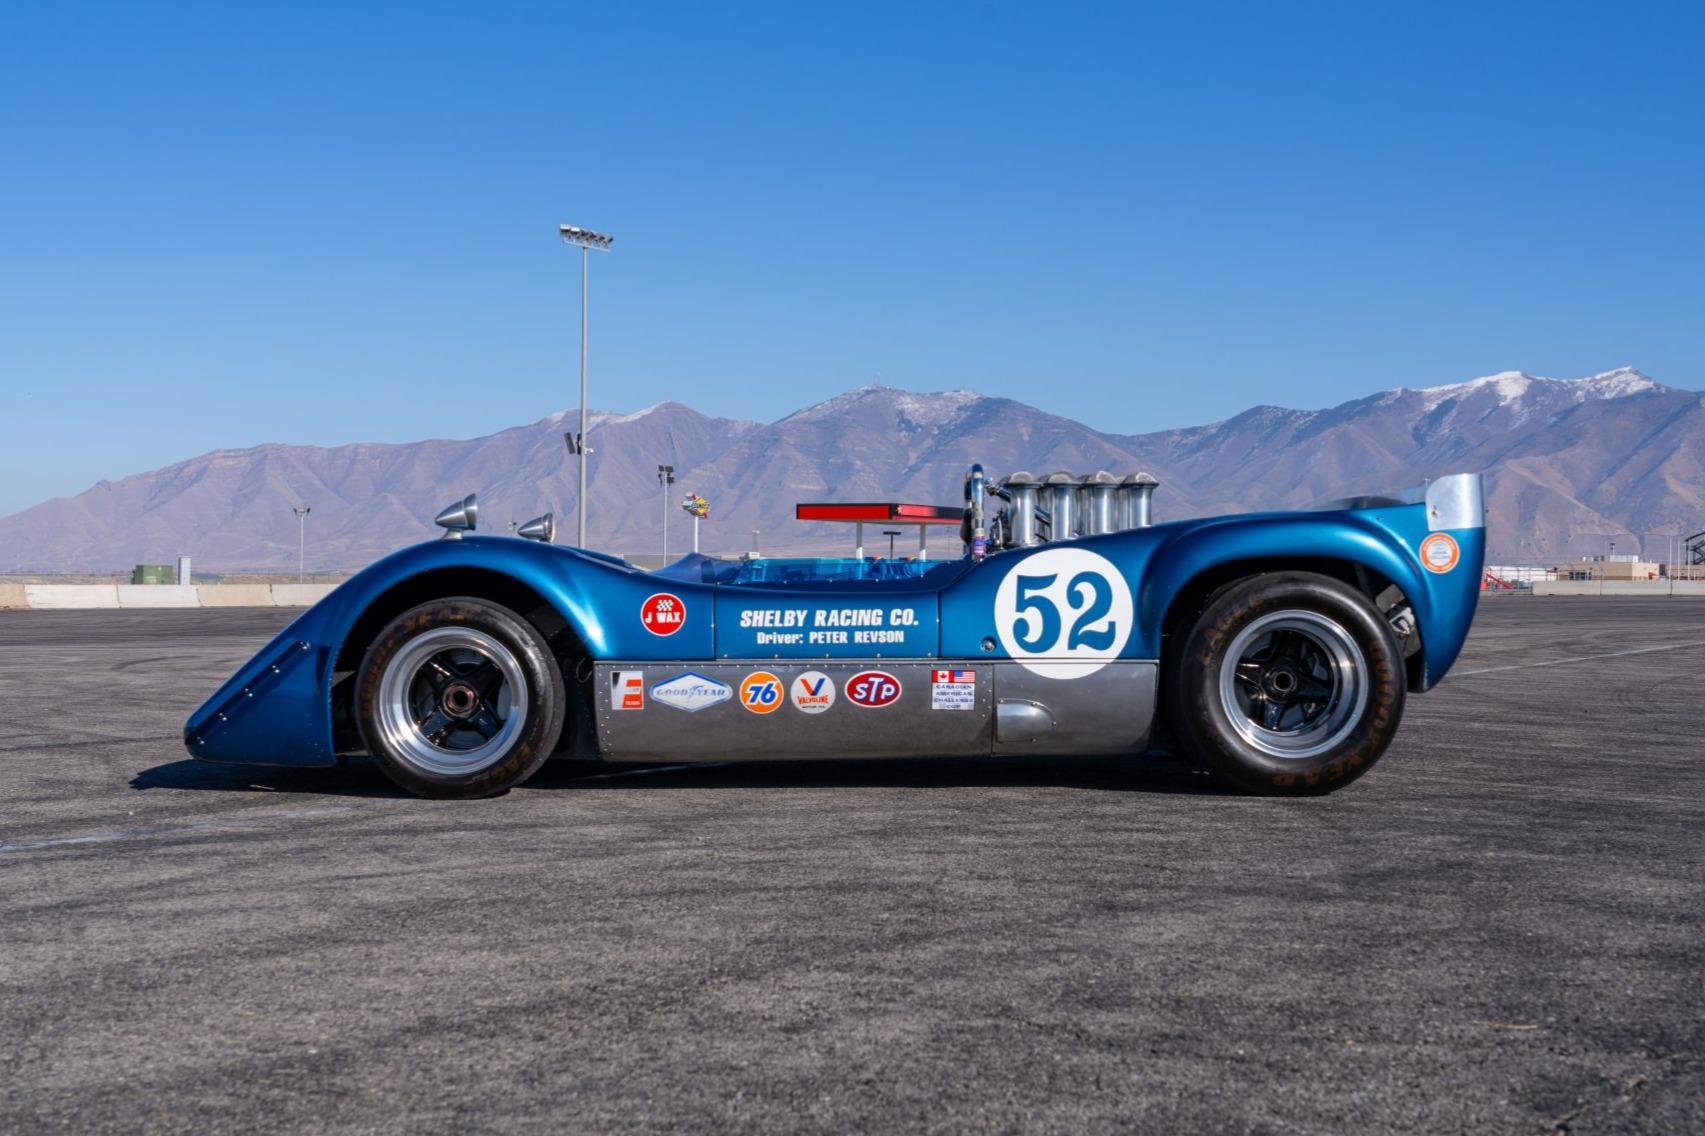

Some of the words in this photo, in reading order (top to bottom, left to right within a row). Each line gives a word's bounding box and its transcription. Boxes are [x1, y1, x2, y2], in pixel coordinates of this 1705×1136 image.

[645, 612, 653, 624] J
[656, 612, 681, 623] WAX
[740, 609, 808, 628] SHELBY
[814, 608, 884, 627] RACING
[890, 608, 919, 626] CO.
[1012, 570, 1116, 654] 52
[756, 631, 804, 645] Driver:
[809, 631, 848, 644] PETER
[854, 630, 905, 644] REVSON
[747, 681, 777, 705] 76
[853, 677, 894, 703] STP
